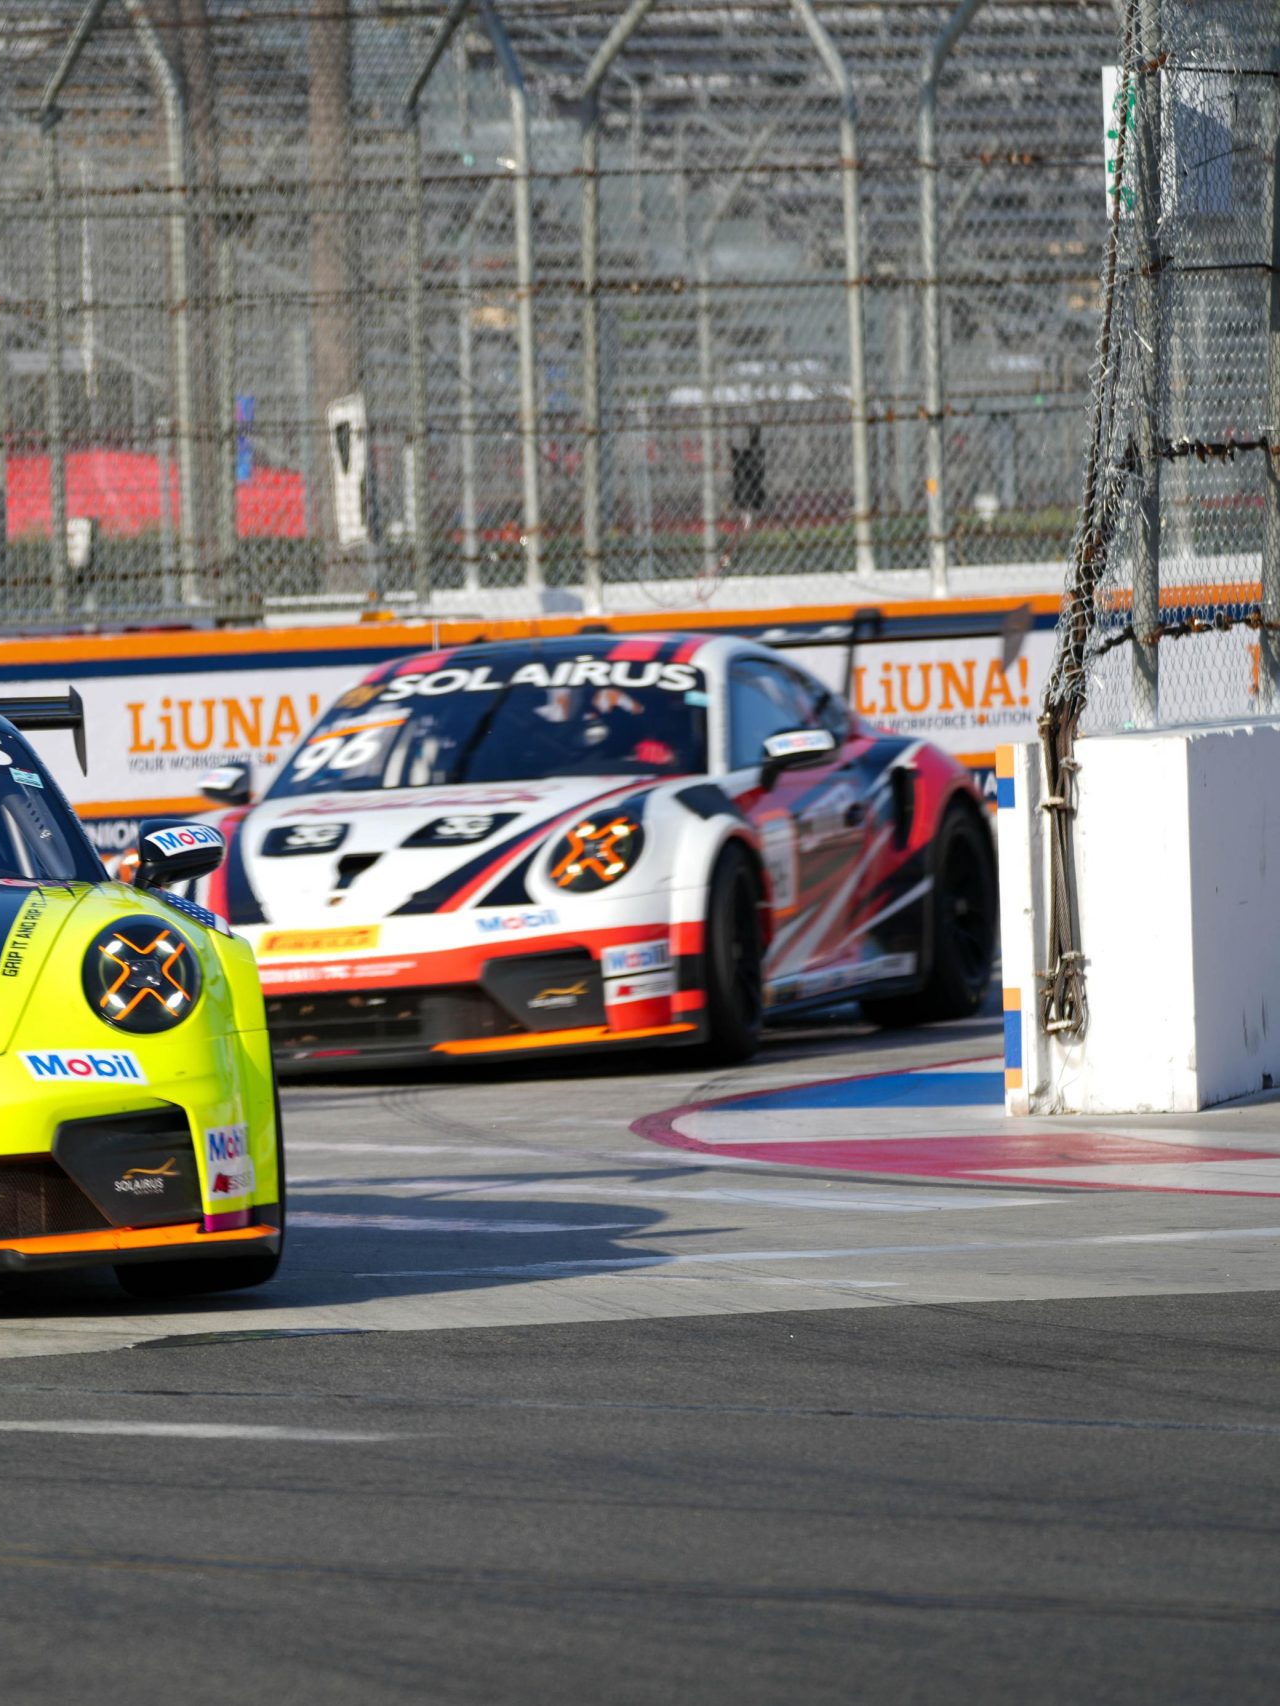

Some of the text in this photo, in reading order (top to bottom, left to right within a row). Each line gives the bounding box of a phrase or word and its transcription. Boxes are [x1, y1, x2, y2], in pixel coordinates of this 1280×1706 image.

[380, 661, 698, 700] SOLAIRUS
[853, 656, 1030, 716] LiUNA!
[290, 730, 381, 782] 96
[154, 827, 220, 850] Mobil
[476, 909, 559, 933] Mobil
[10, 941, 29, 950] IT
[1, 951, 24, 977] GRIP
[26, 1054, 140, 1079] Mobil
[113, 1178, 165, 1192] SOLAIRUS
